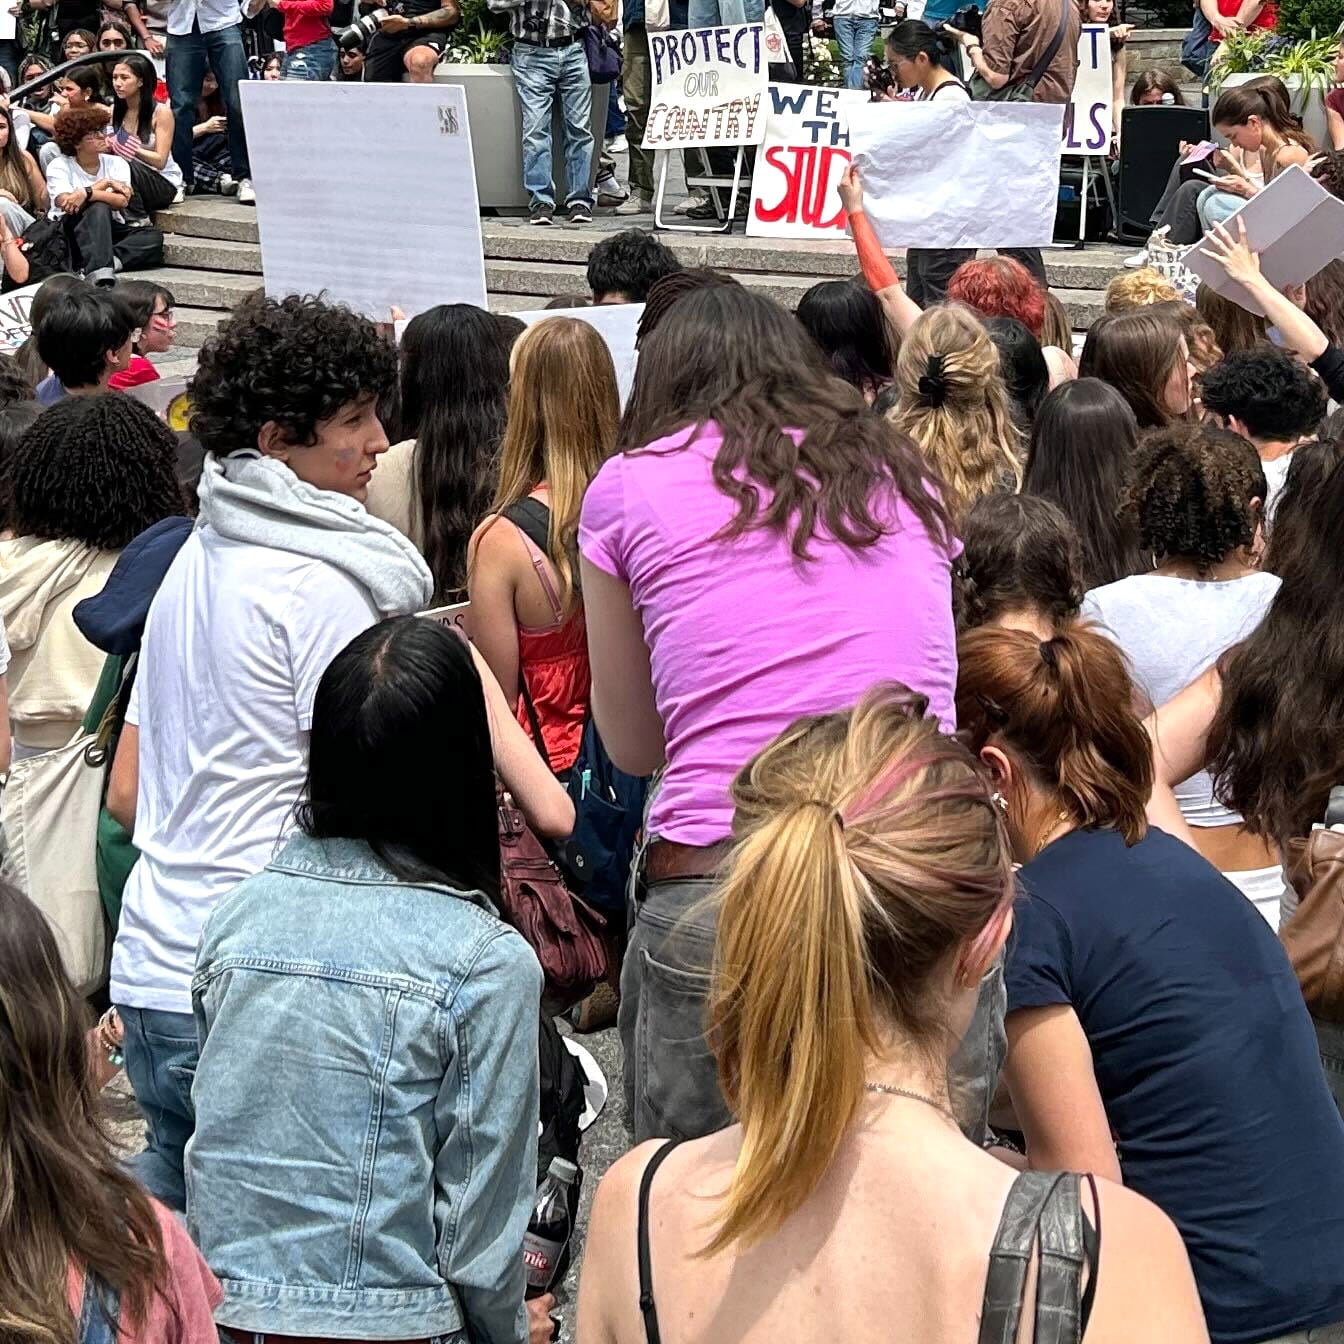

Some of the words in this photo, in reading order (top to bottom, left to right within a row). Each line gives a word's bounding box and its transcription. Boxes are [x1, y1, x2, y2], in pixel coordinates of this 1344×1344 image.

[652, 26, 763, 85] PROTECT
[684, 70, 719, 97] OUR
[768, 86, 839, 119] WE
[646, 93, 762, 144] COUNTRY
